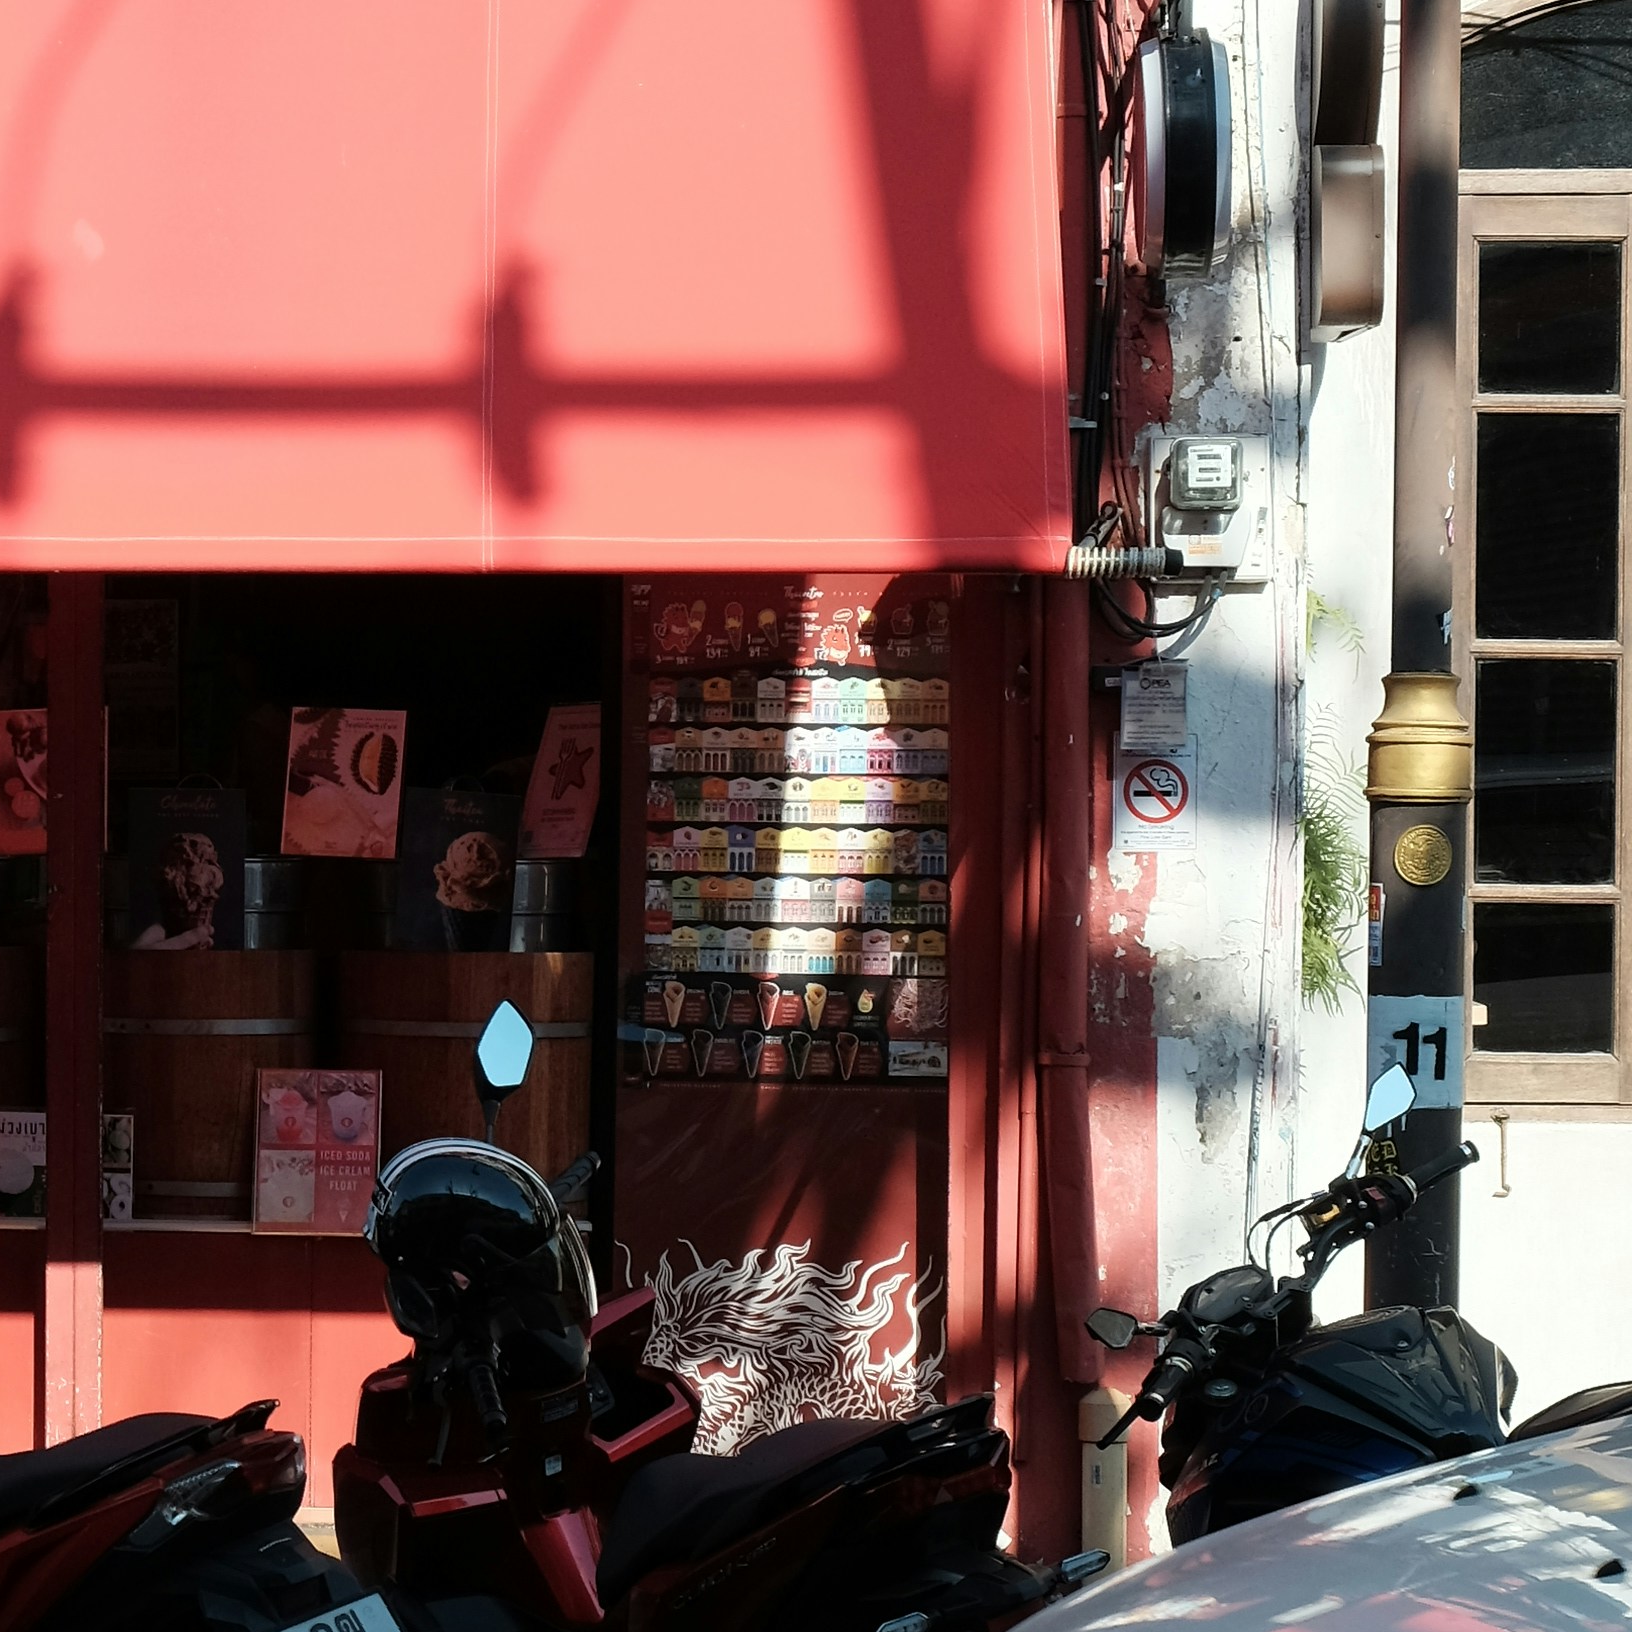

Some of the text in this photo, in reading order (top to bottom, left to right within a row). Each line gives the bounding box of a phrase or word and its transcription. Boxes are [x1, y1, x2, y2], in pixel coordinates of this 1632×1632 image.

[1393, 1022, 1448, 1080] 11
[320, 1150, 371, 1161] ICED SODA
[319, 1165, 371, 1176] ICE CREAM
[329, 1180, 358, 1191] FLOAT
